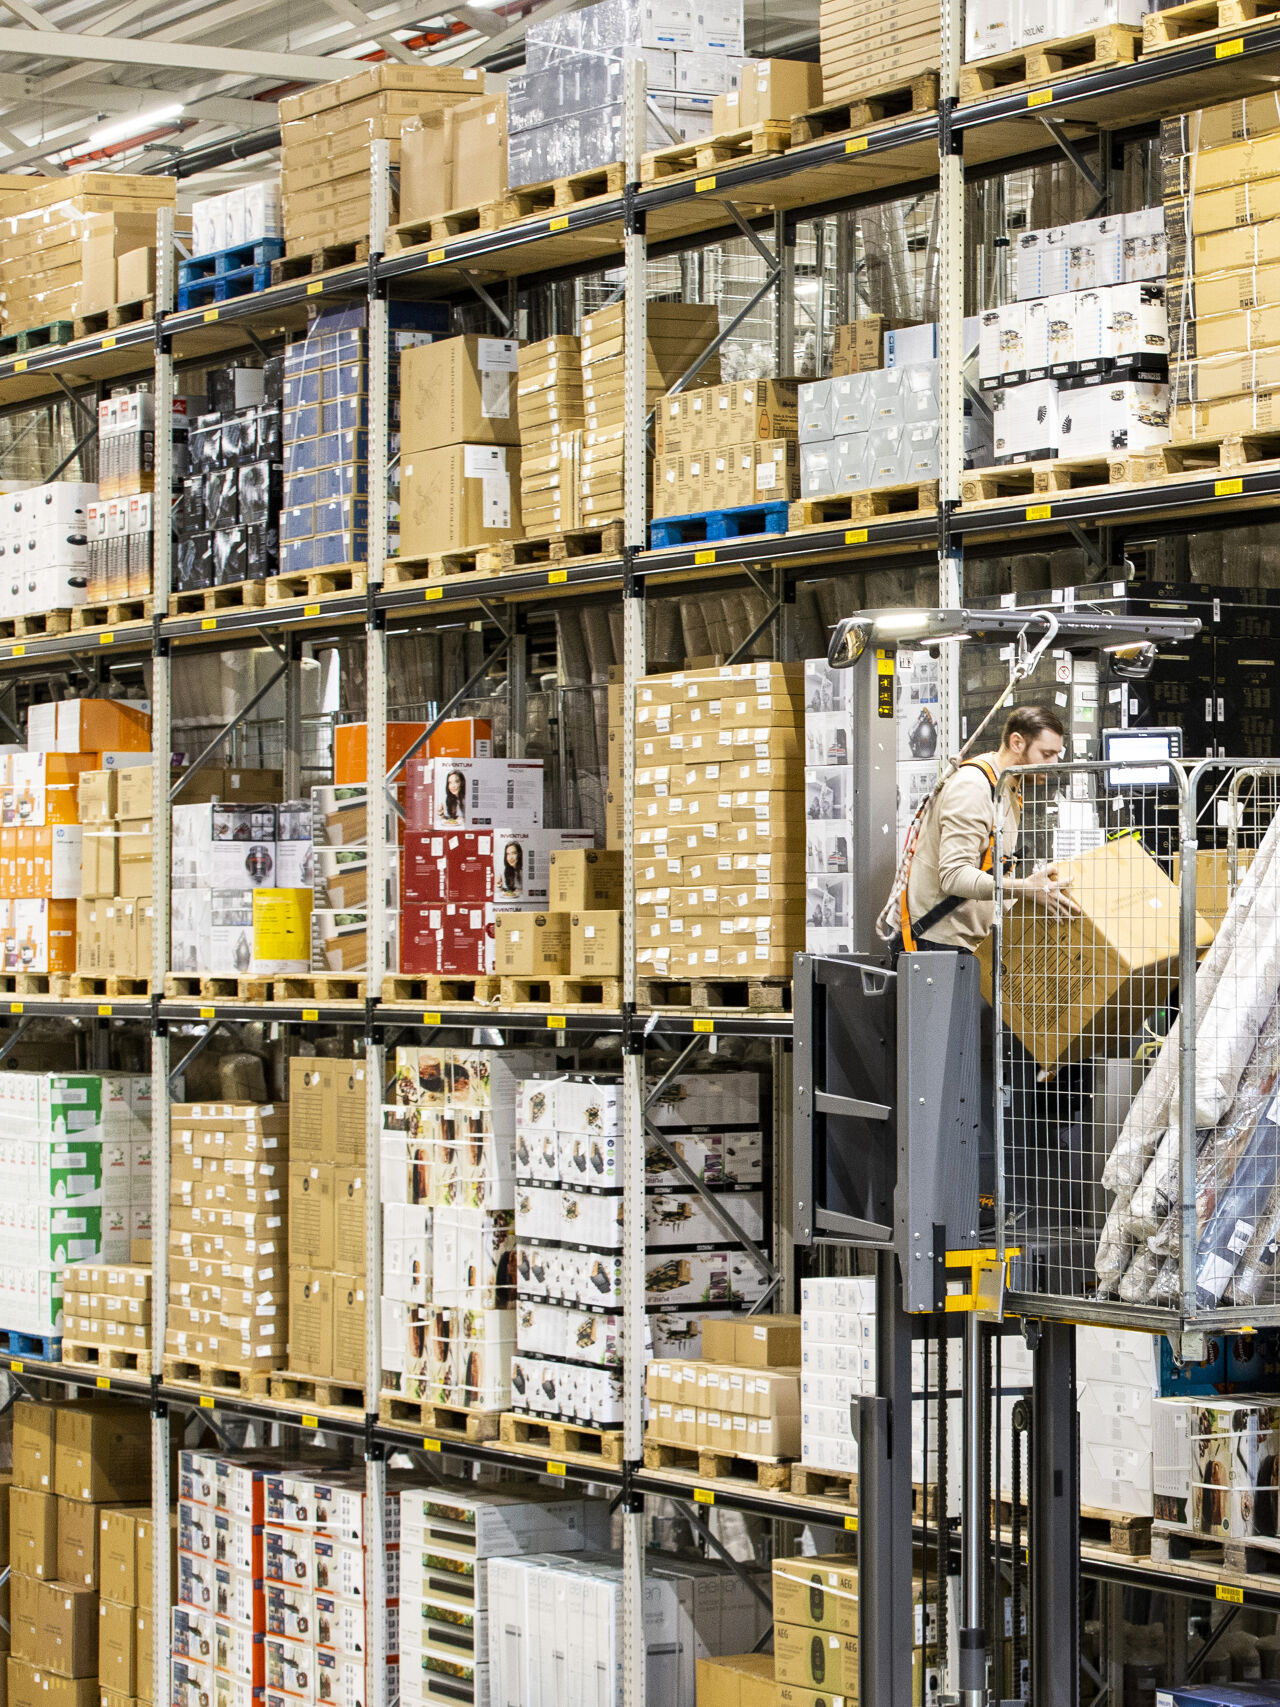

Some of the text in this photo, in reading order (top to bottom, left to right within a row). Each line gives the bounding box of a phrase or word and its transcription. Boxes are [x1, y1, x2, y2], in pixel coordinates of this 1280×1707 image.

[840, 1578, 852, 1590] AEG
[778, 1628, 788, 1640] AEG
[845, 1641, 858, 1652] AEG
[781, 1690, 792, 1701] AEG
